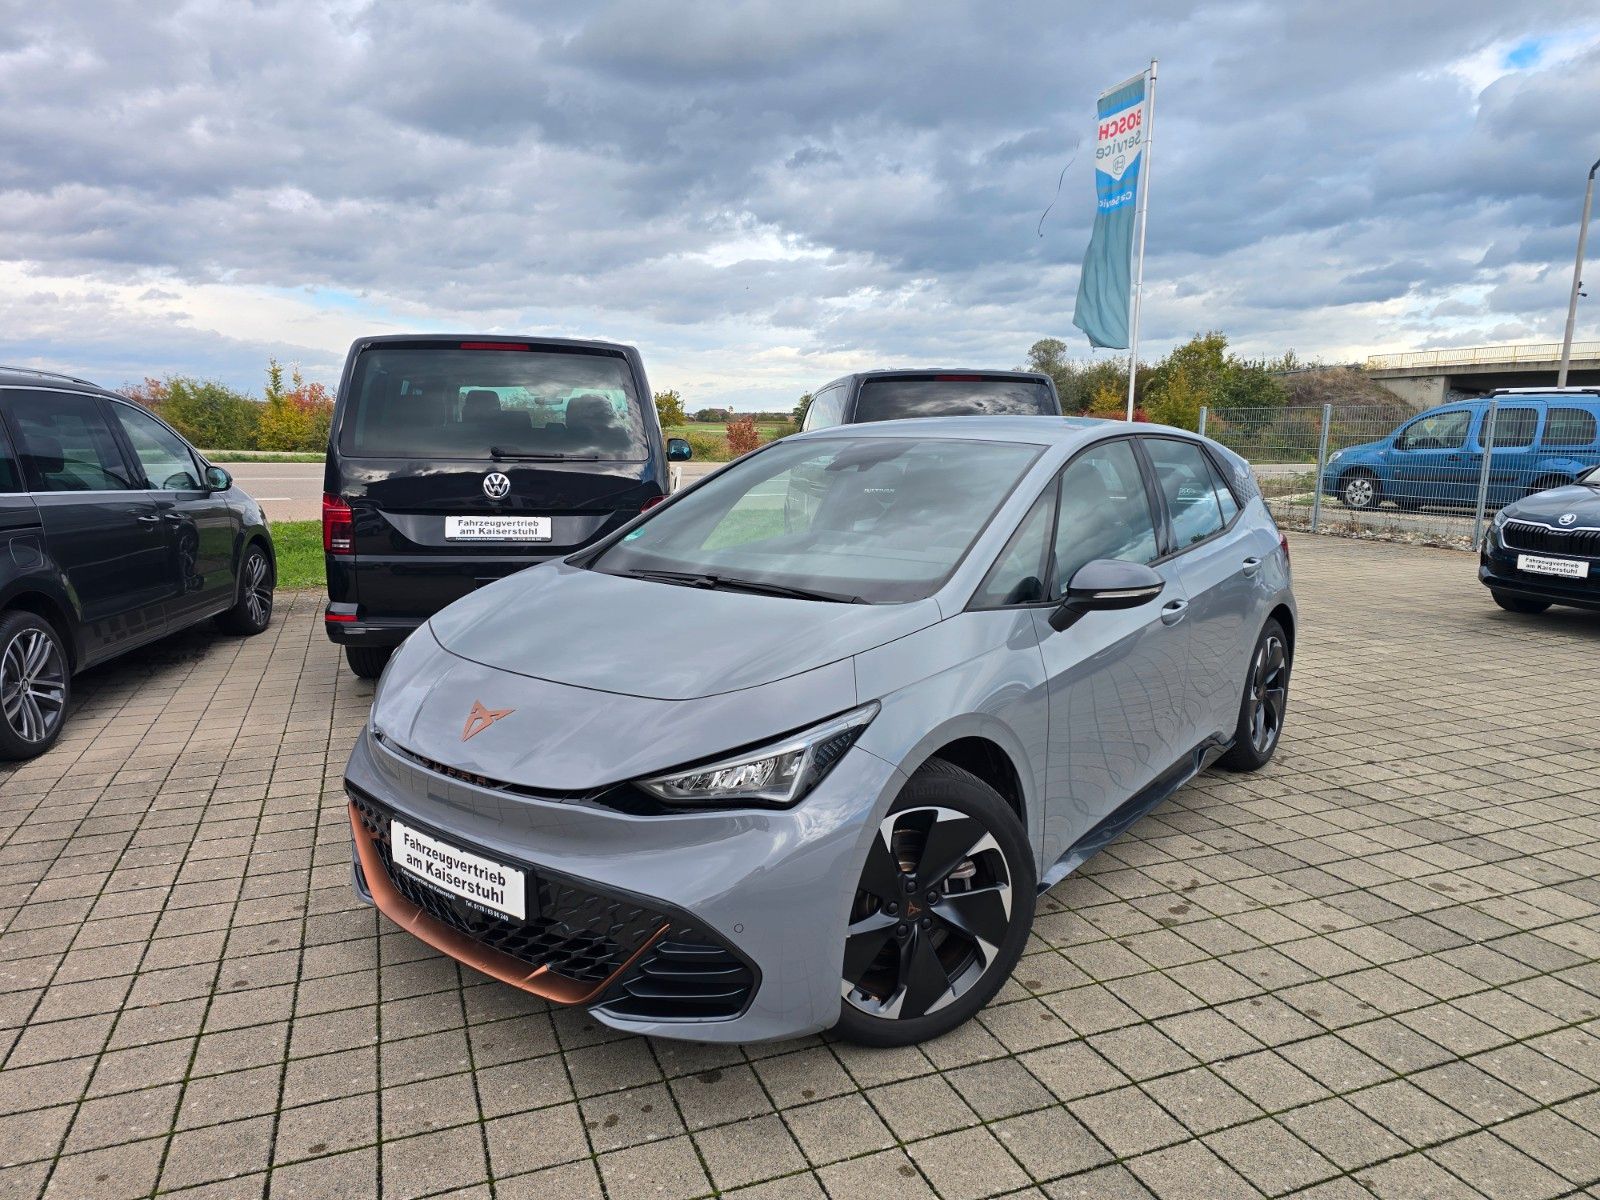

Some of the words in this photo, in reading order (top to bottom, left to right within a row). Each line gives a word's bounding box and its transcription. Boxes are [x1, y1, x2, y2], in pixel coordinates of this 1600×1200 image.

[458, 519, 539, 528] Fahrzeugvertrieb
[478, 527, 538, 536] Kaiserstuhl
[1525, 557, 1579, 569] Fahrzeugvertrieb
[1537, 565, 1578, 574] Kaiserstuhl
[403, 832, 506, 887] Fahrzeugvertrieb
[406, 853, 423, 870] am
[425, 860, 504, 905] Kaiserstuhl
